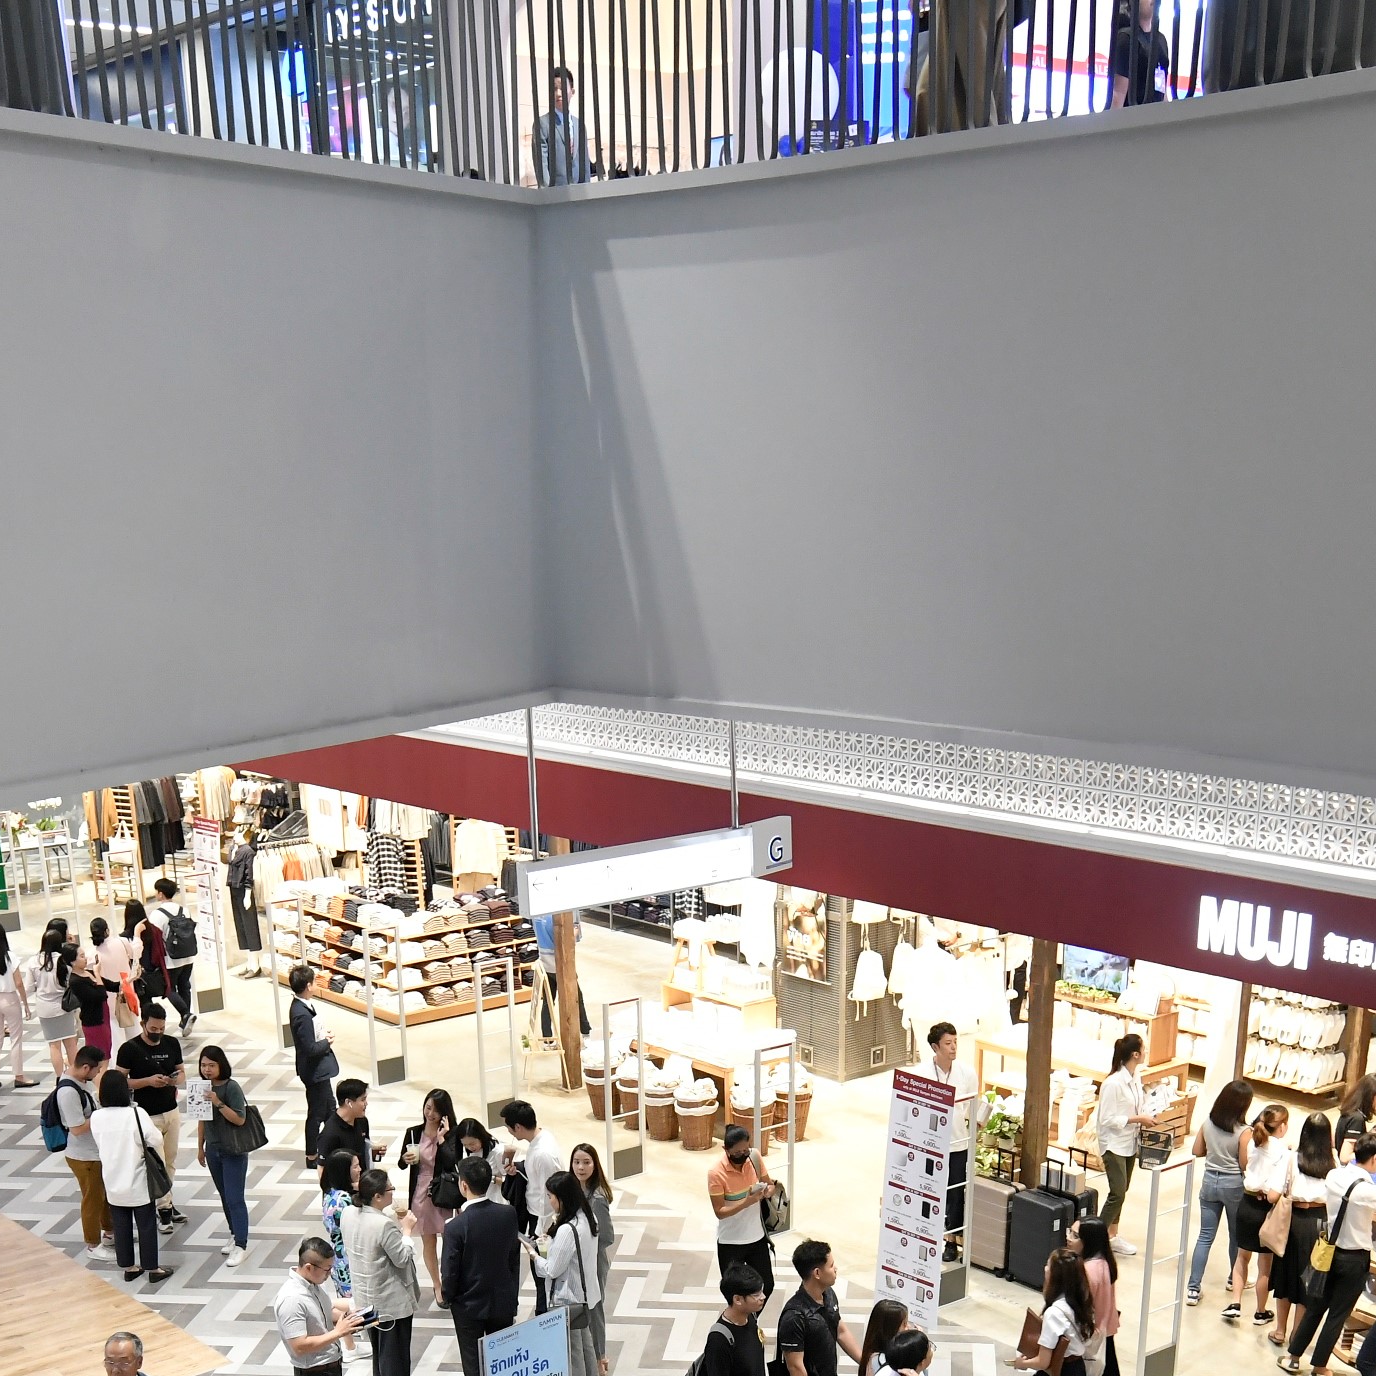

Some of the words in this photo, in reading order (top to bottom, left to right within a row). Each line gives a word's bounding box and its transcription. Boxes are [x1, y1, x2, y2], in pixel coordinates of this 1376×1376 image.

[769, 836, 783, 863] G
[1197, 895, 1313, 971] MUJI
[896, 1074, 909, 1084] 1-Day
[910, 1078, 927, 1089] Special
[928, 1084, 953, 1096] Promotion
[539, 1314, 563, 1328] SAMYAN
[490, 1347, 529, 1375] ซักแห้ง
[533, 1358, 549, 1374] รีด
